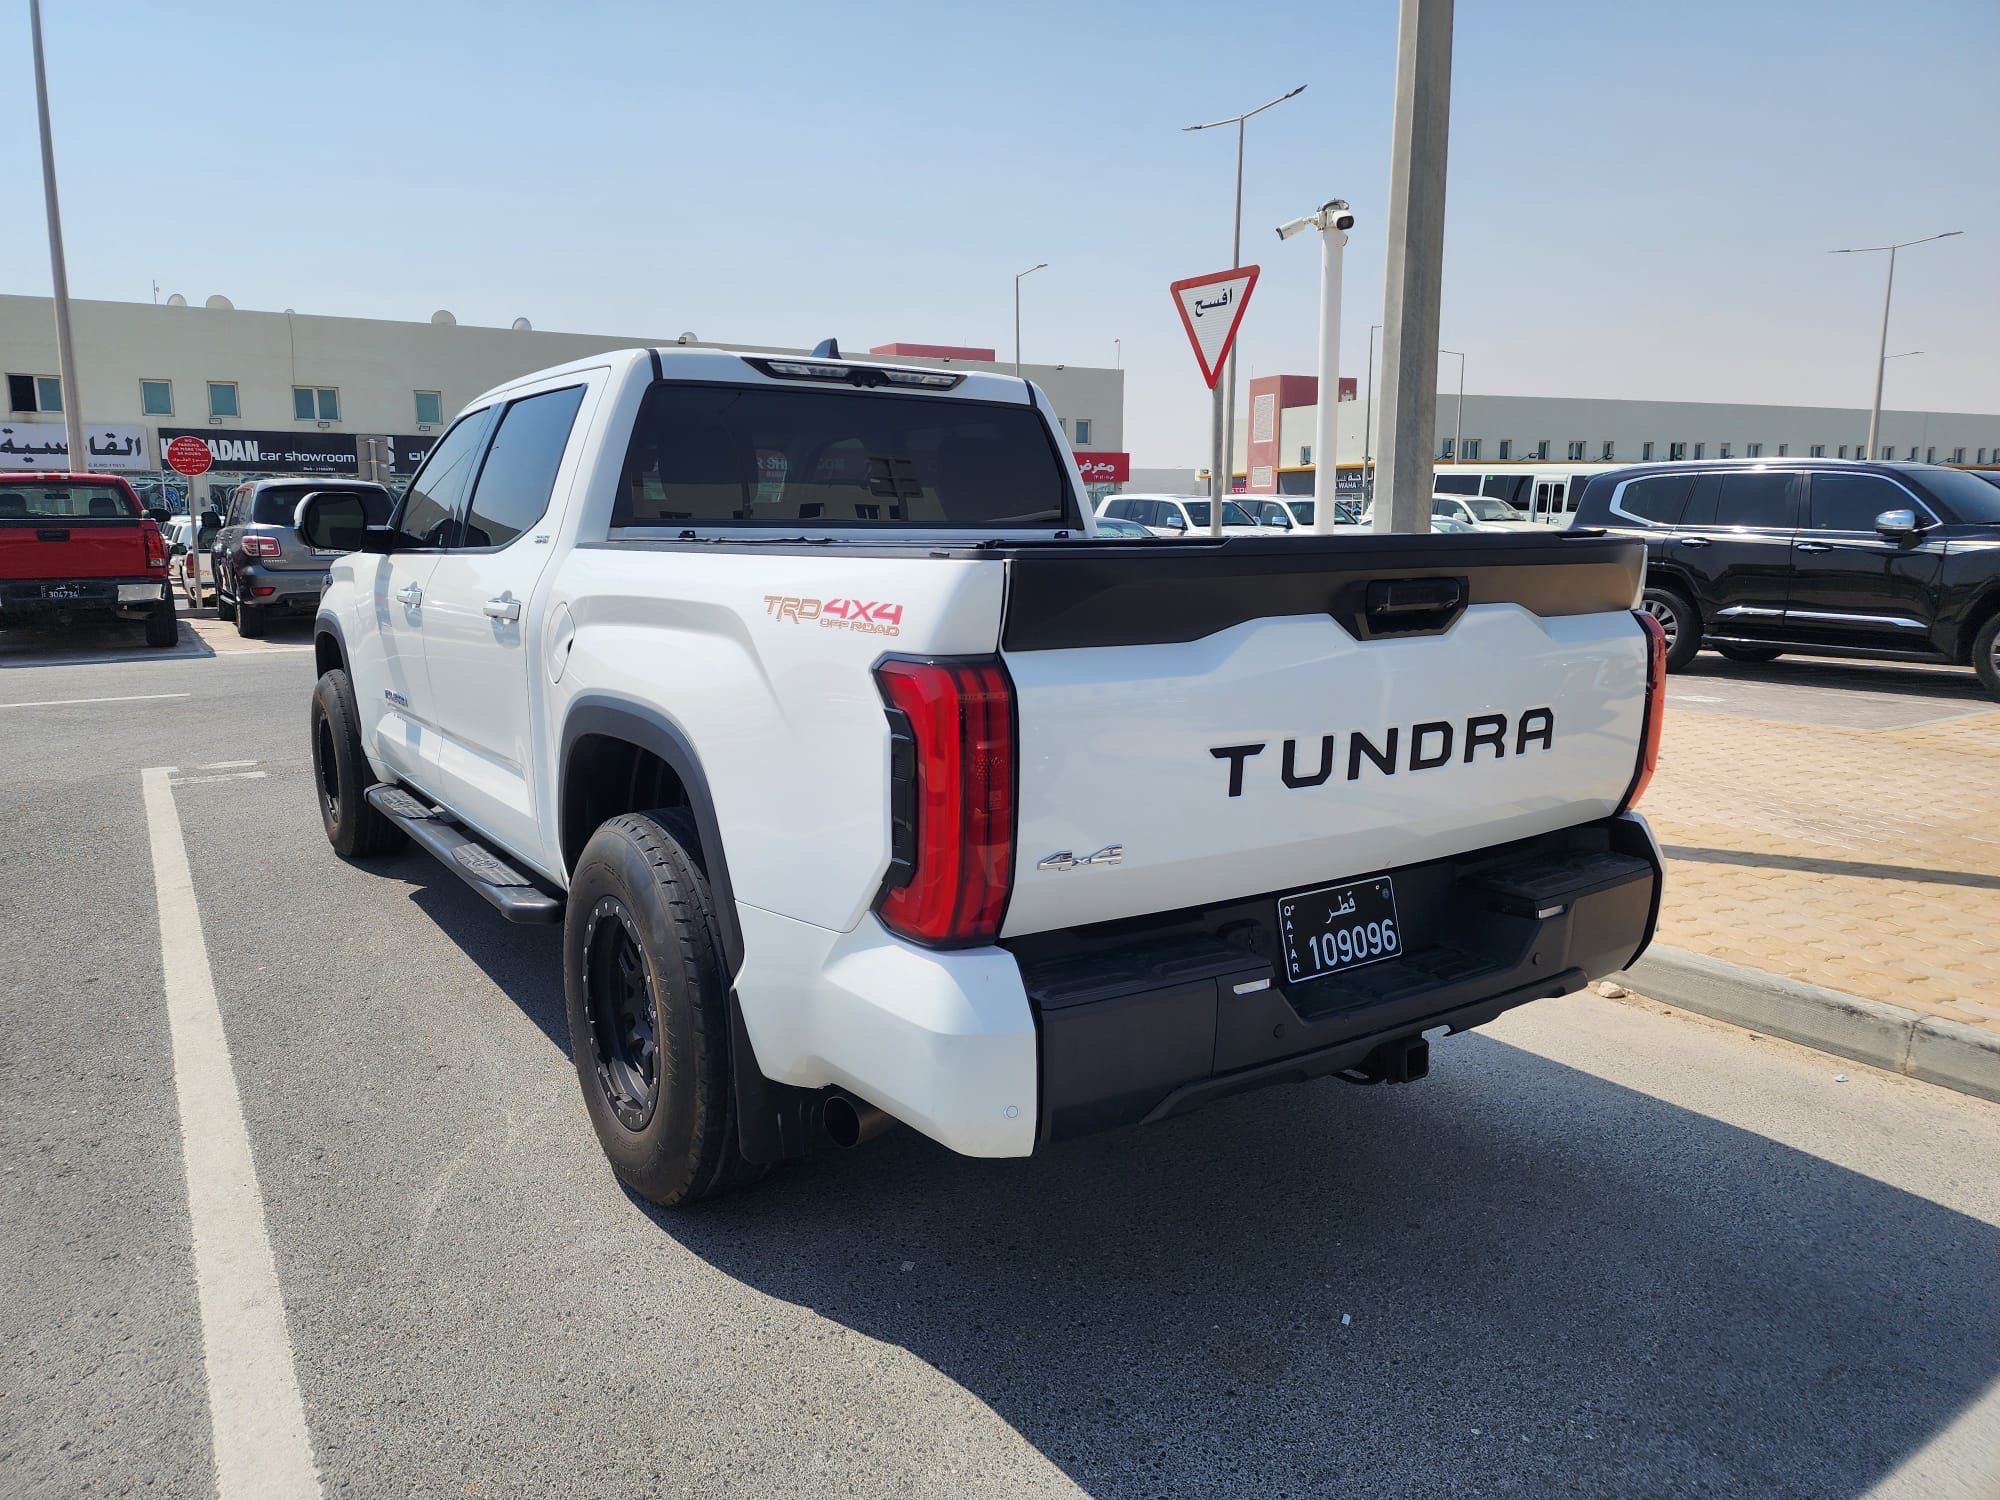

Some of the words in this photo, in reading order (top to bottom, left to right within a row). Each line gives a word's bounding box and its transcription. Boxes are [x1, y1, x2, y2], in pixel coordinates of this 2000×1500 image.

[1194, 287, 1233, 318] افسح
[0, 428, 142, 463] القاسية
[260, 451, 281, 462] car
[285, 450, 356, 463] showroom
[764, 595, 822, 624] TRD
[823, 598, 903, 625] 4X4
[820, 618, 849, 629] OFF
[850, 621, 900, 637] ROAD
[1209, 706, 1554, 797] TUNDRA
[1325, 891, 1356, 924] قطر
[1309, 919, 1397, 970] 109096
